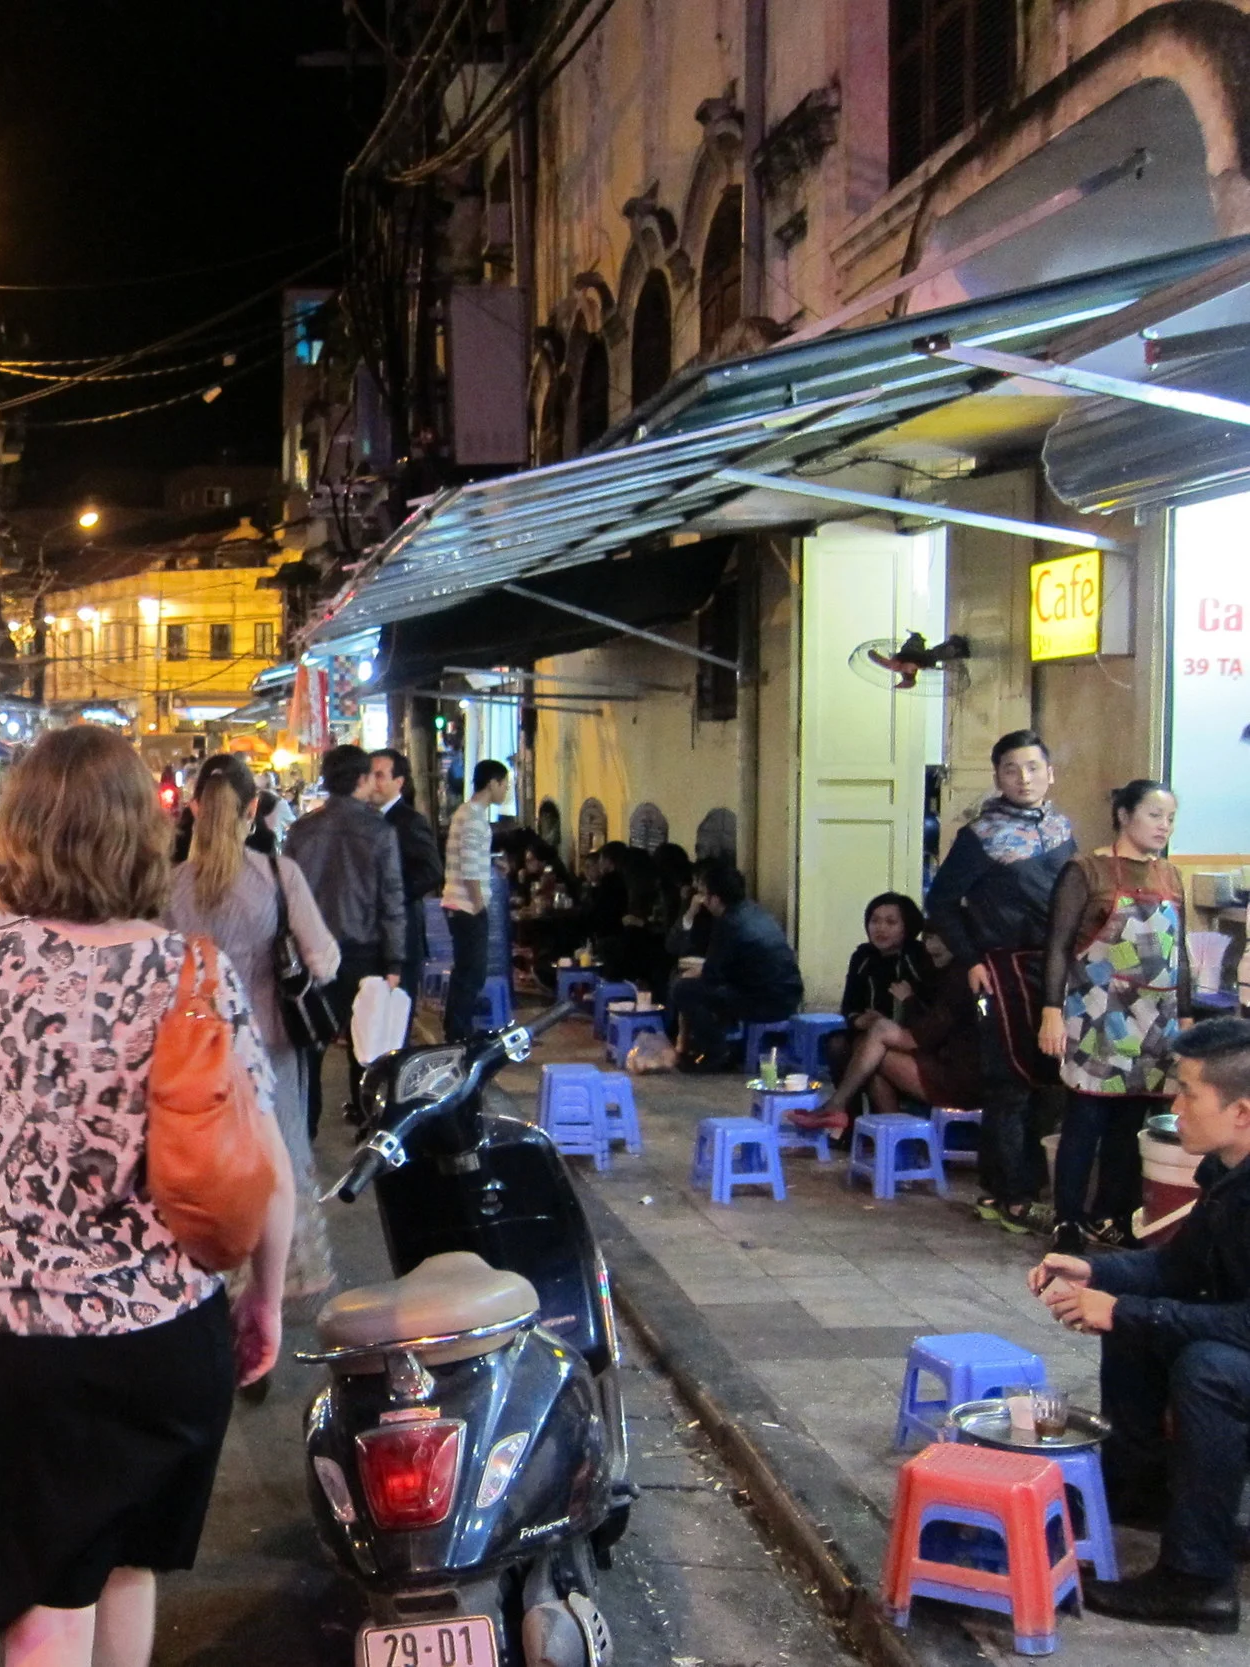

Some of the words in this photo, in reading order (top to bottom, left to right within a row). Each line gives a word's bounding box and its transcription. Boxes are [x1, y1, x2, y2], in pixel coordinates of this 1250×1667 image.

[1035, 560, 1095, 622] Café
[1183, 656, 1210, 677] 39
[1216, 656, 1244, 682] TẠ
